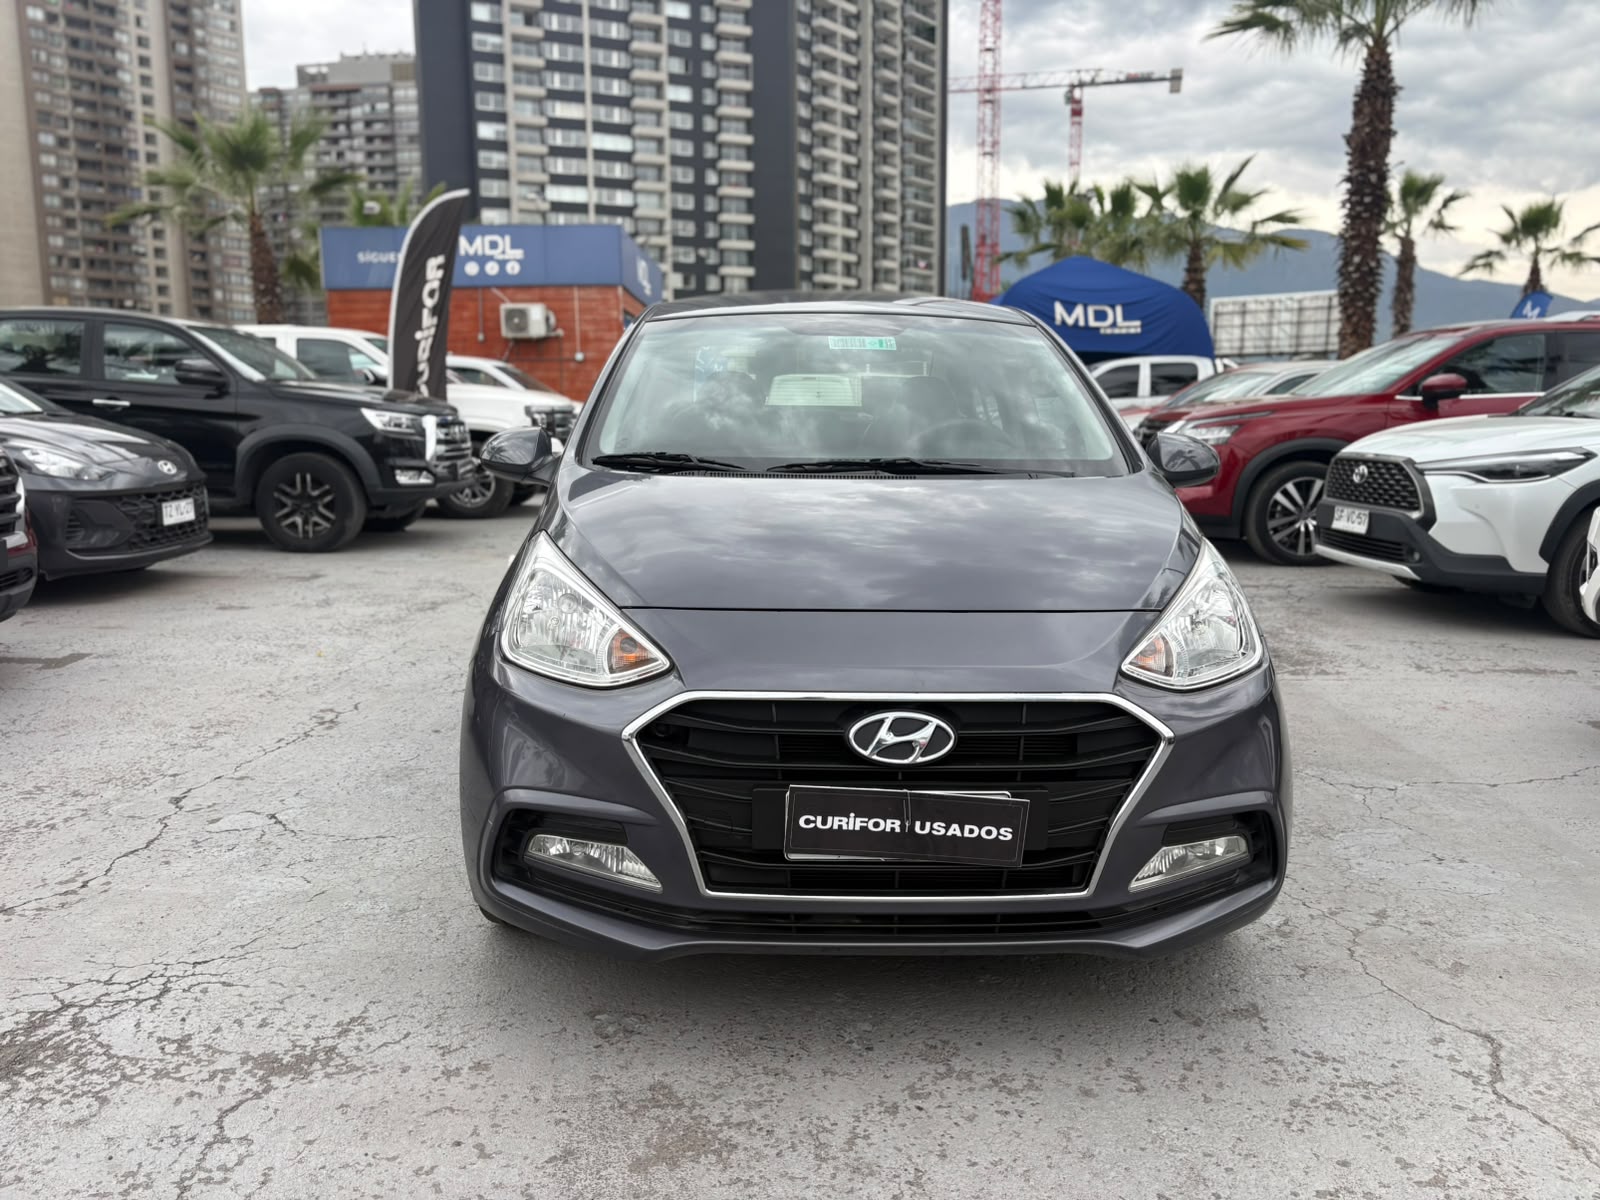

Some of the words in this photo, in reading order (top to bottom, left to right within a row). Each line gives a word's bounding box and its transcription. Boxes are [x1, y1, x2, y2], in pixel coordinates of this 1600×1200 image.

[458, 234, 524, 256] MDL
[1054, 300, 1142, 328] MDL
[914, 820, 1013, 841] USADOS
